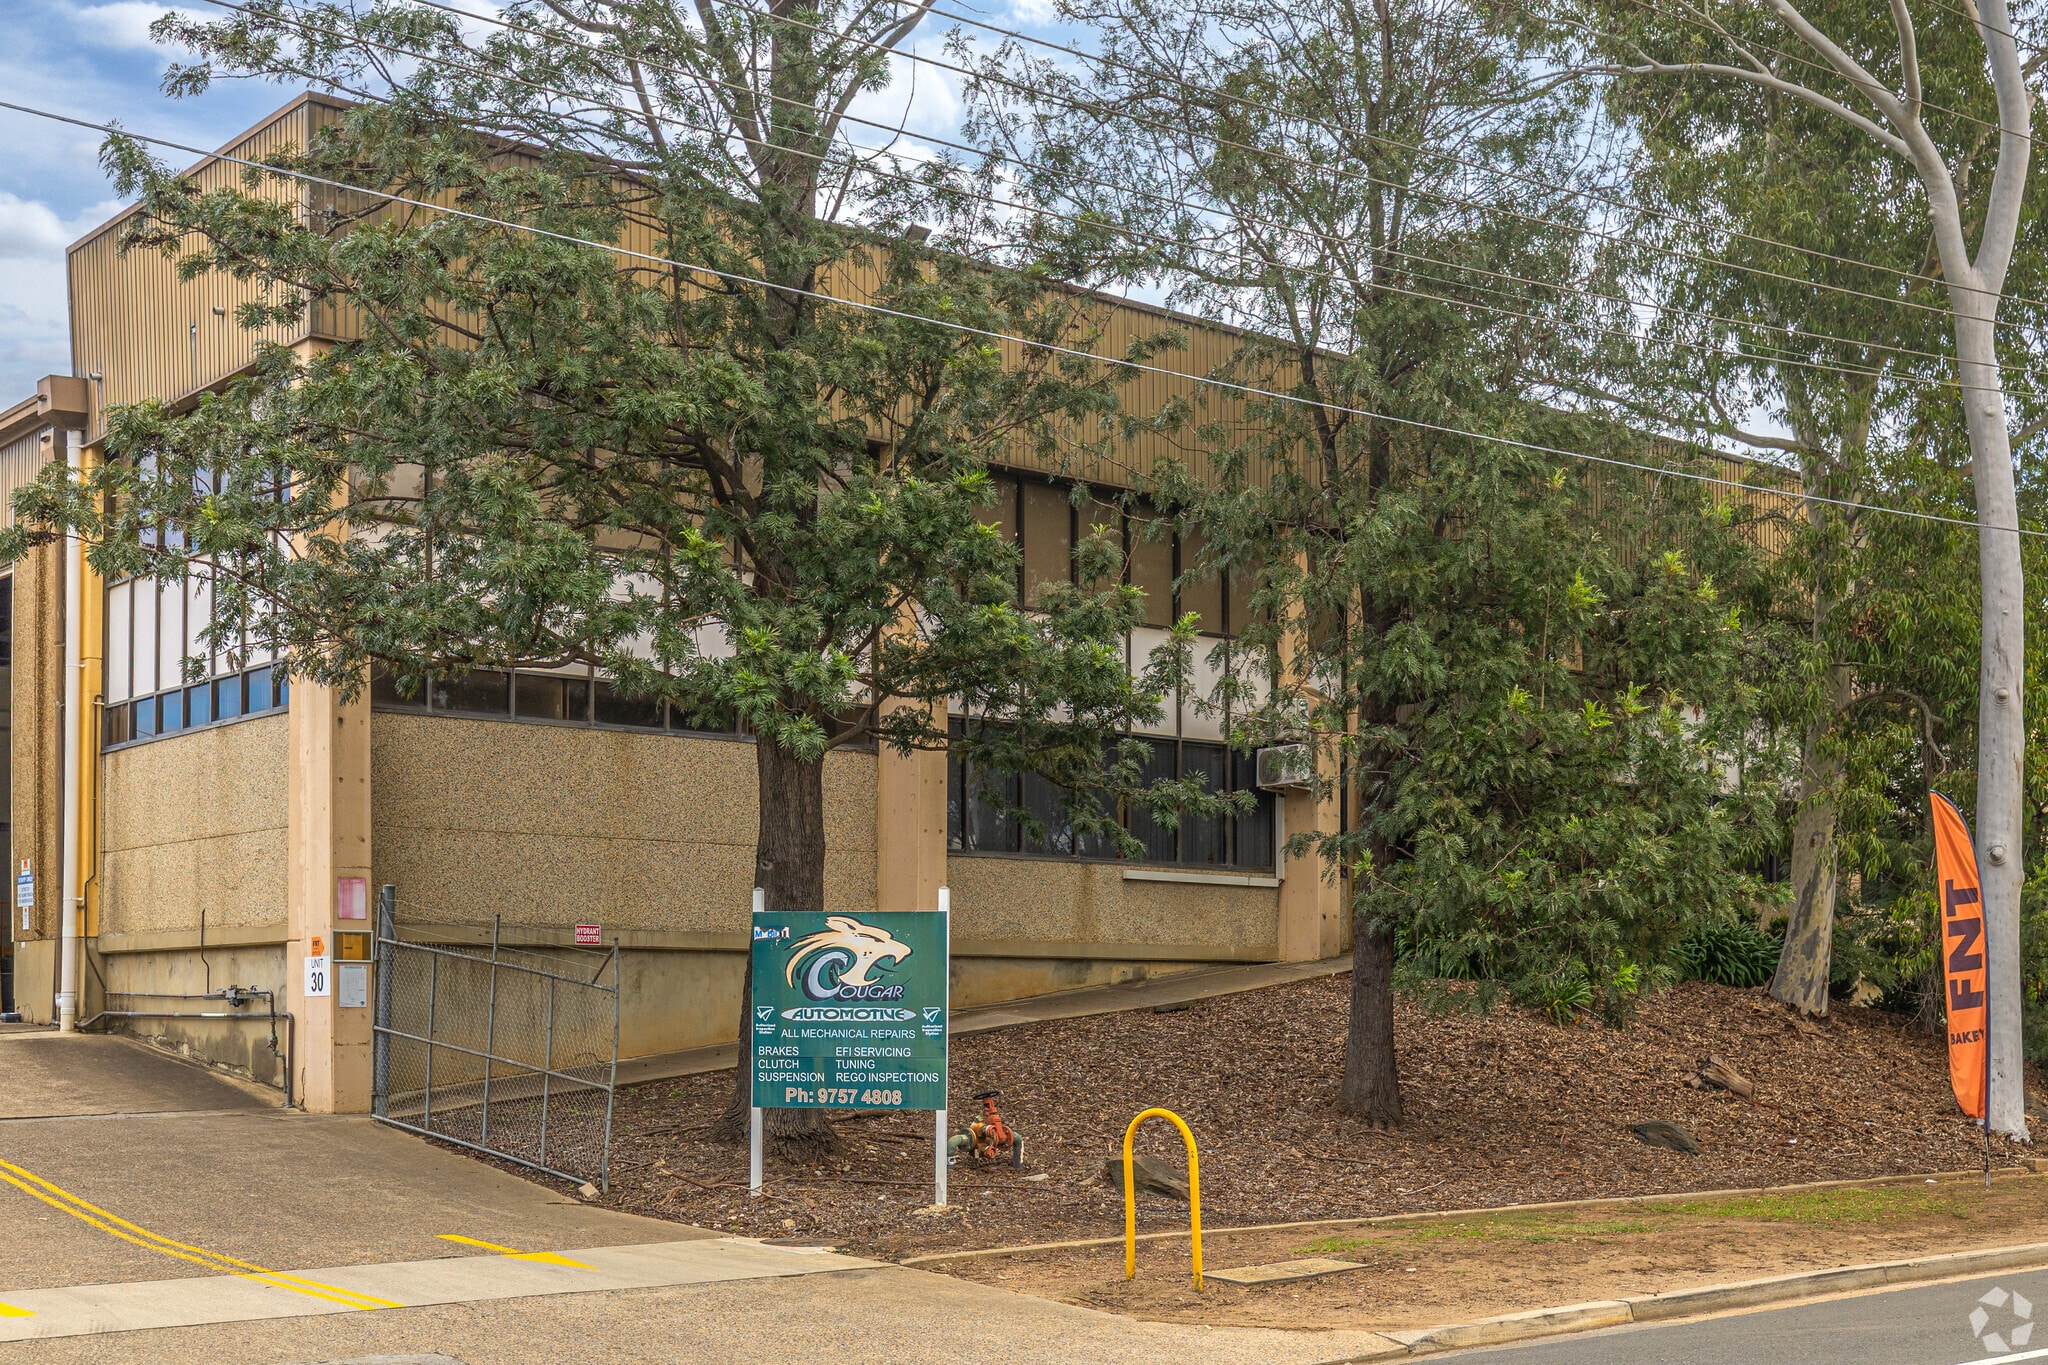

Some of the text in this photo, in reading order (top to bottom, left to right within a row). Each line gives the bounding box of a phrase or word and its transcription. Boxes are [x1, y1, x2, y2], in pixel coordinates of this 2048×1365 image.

[1945, 879, 1984, 1011] FNT
[311, 958, 324, 968] UNIT
[807, 951, 905, 999] COUGAR
[311, 972, 324, 992] 30
[792, 1007, 905, 1021] AUTOMOTIVE
[781, 1029, 916, 1039] ALL MECHANICAL REPAIRS
[758, 1046, 799, 1056] BRAKES
[835, 1047, 911, 1057] EFI SERVICING
[758, 1059, 799, 1069] CLUTCH
[836, 1060, 875, 1069] TUNING
[758, 1072, 825, 1082] SUSPENSION
[836, 1073, 939, 1083] REGO INSPECTIONS
[785, 1088, 903, 1105] Ph: 9757 4808
